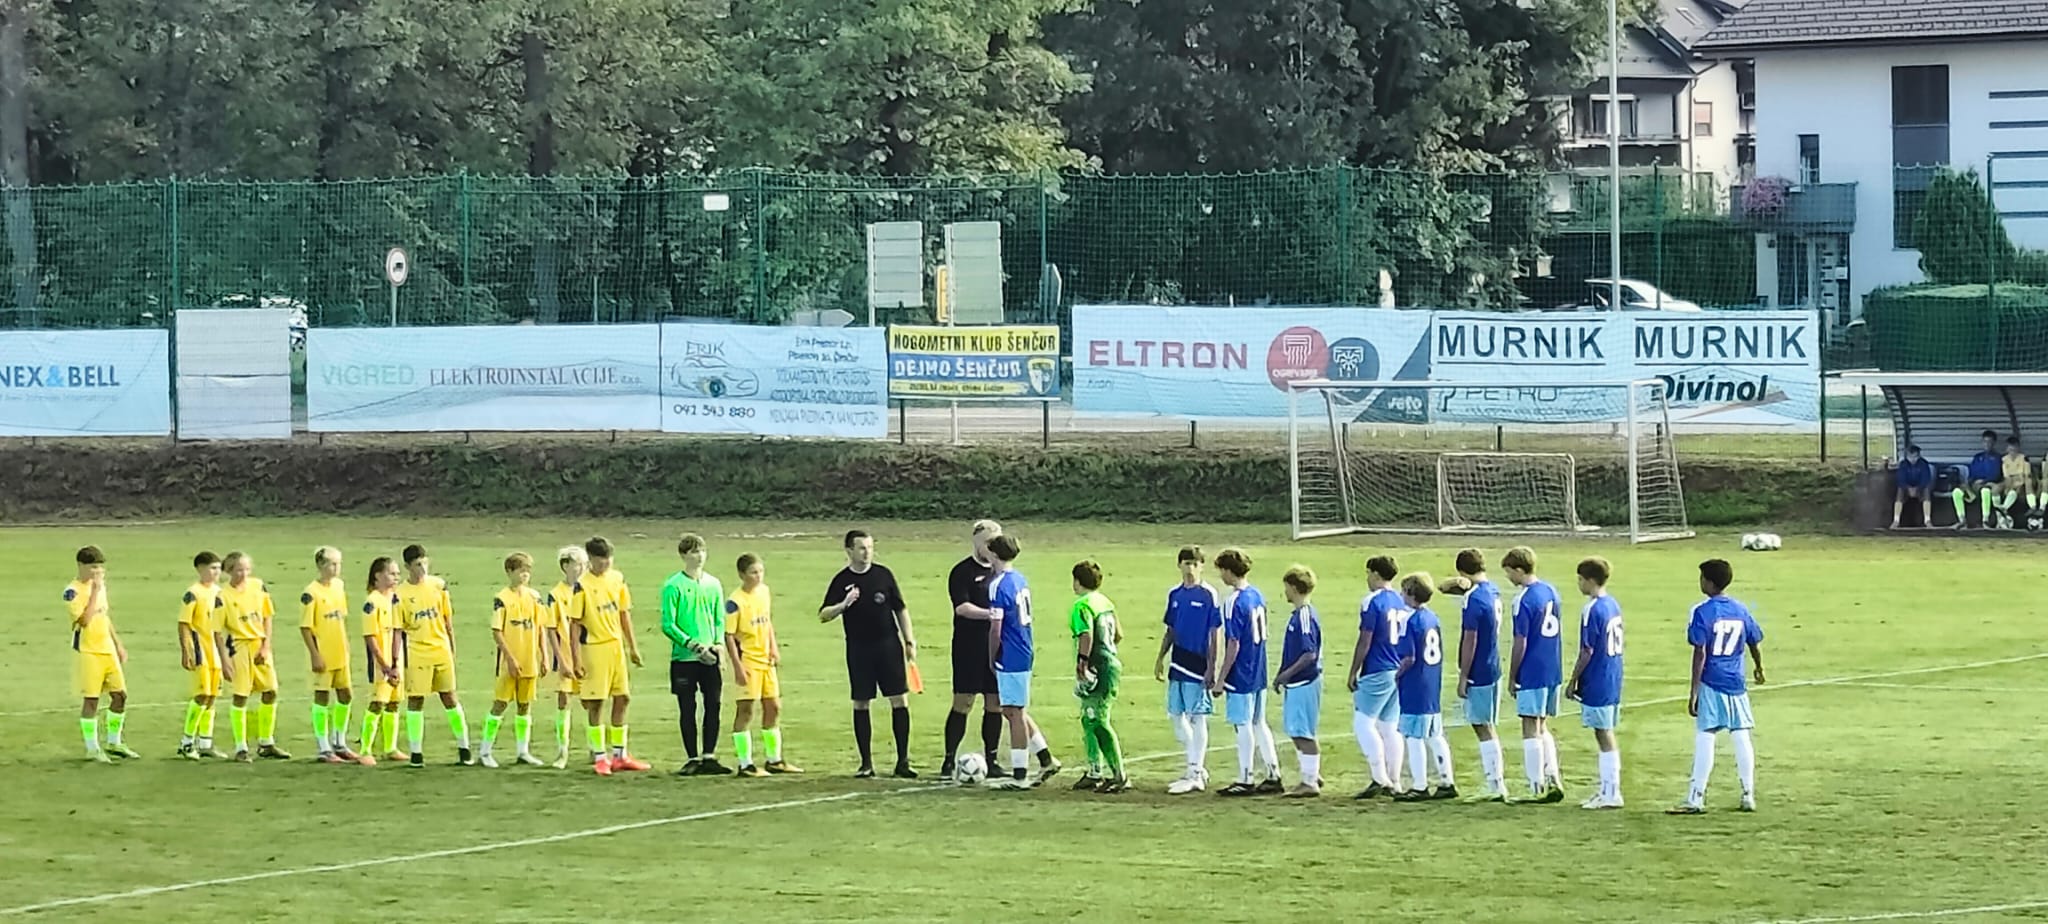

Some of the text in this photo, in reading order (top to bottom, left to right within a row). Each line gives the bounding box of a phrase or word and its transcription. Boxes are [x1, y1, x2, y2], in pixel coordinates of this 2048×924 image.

[686, 341, 725, 356] ERIK
[894, 331, 1056, 352] NOGOMETNI KLUB ŠENČUR
[1089, 340, 1248, 370] ELTRON
[1438, 325, 1605, 358] MURNIK
[1635, 326, 1807, 359] MURNIK
[322, 364, 414, 386] VIGRED
[430, 367, 619, 387] ELEKTROINSTALACIJE
[895, 357, 1022, 378] DEJMO ŠENČUR
[1651, 374, 1768, 402] Divinol
[702, 404, 725, 417] 543
[729, 406, 756, 418] 880
[1541, 601, 1559, 638] 6
[1424, 628, 1441, 665] 8
[1713, 619, 1744, 656] 17
